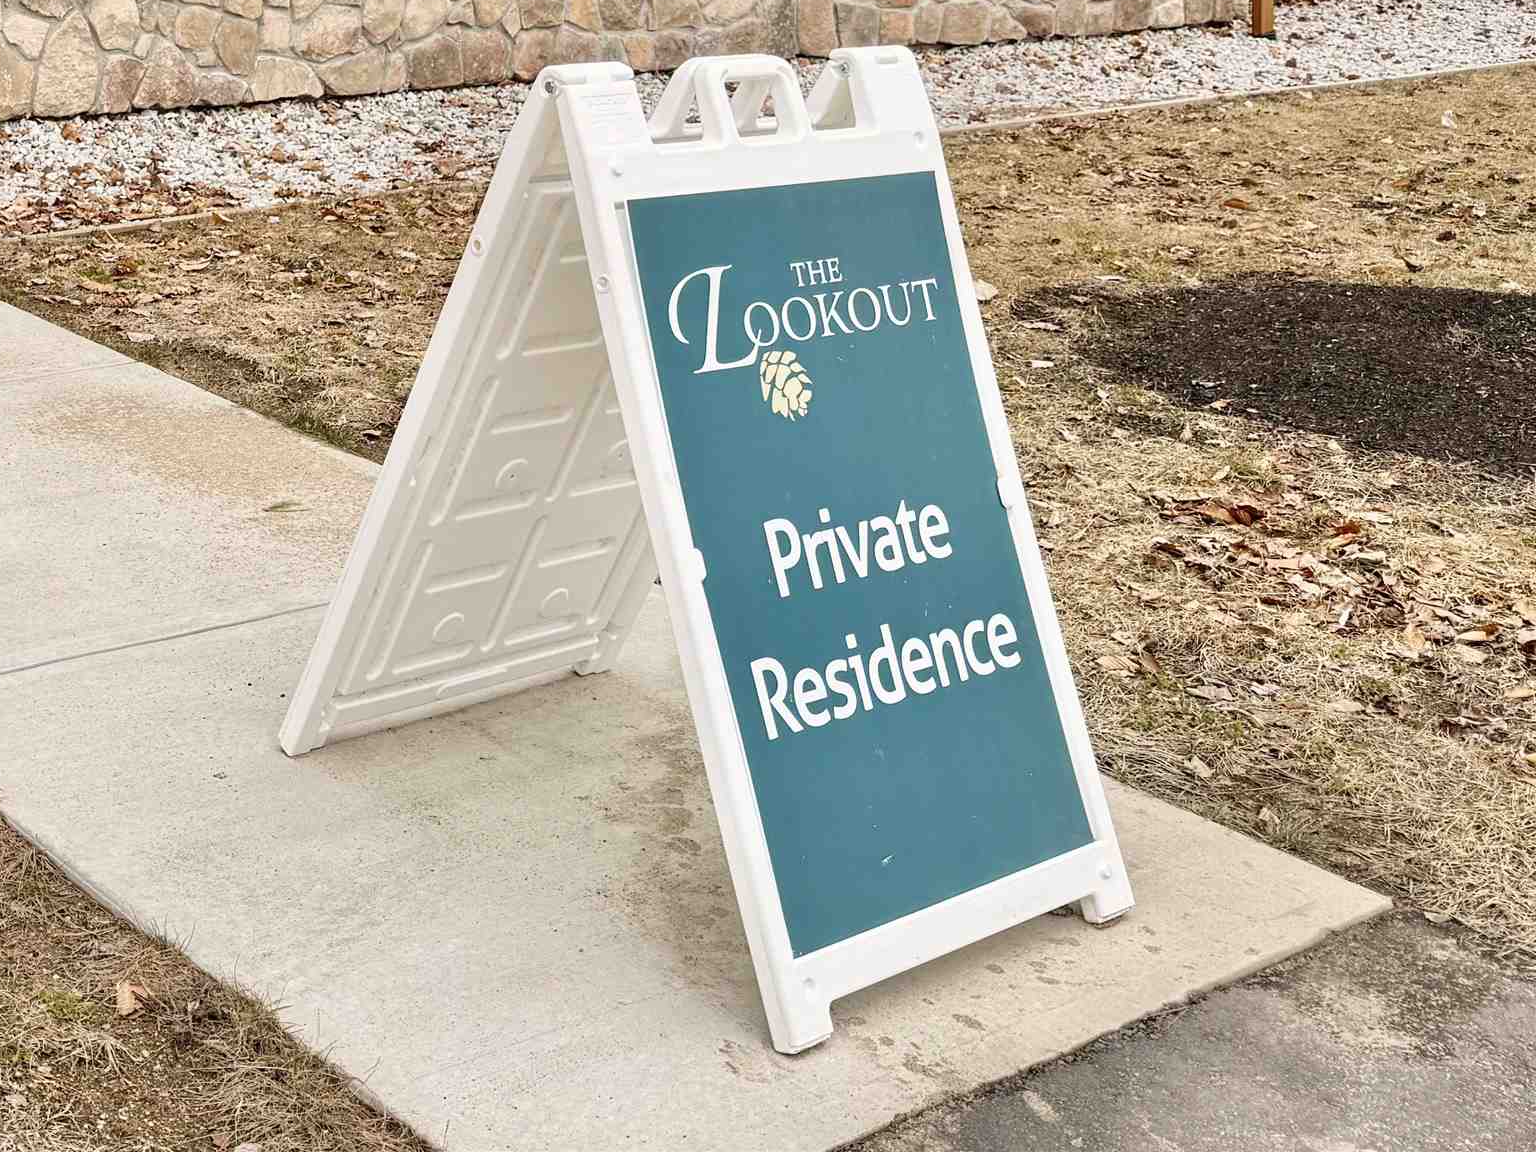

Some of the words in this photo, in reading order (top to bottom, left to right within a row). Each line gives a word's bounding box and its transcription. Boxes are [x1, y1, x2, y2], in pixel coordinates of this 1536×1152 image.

[790, 257, 843, 287] THE
[763, 499, 953, 599] Private
[750, 612, 1022, 741] Residence
